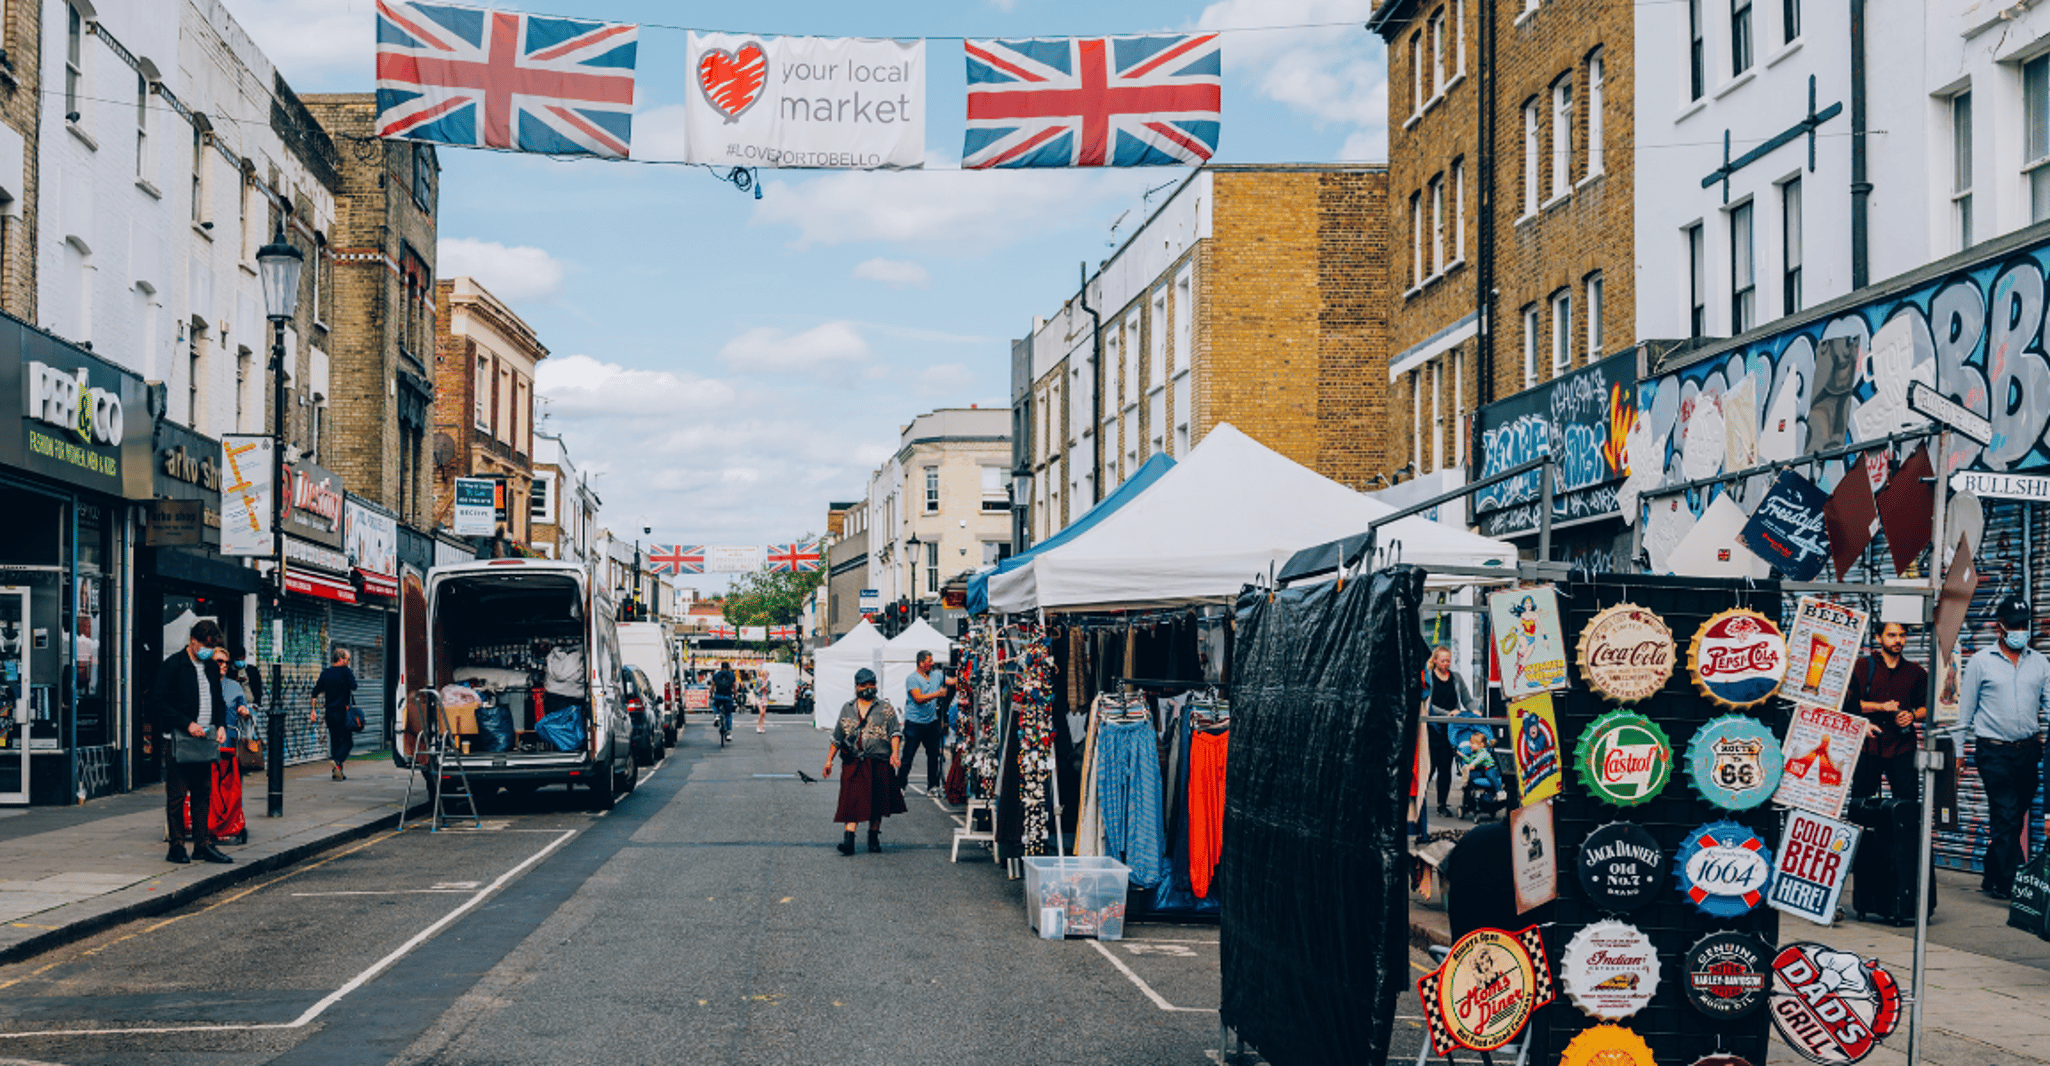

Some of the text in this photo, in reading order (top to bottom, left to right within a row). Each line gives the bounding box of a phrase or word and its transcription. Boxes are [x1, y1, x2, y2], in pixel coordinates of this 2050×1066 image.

[781, 58, 908, 84] your local
[781, 91, 910, 124] market
[726, 144, 880, 166] #LOVEPORTOBELLO
[201, 456, 222, 493] sh
[1758, 495, 1824, 536] Freestyle
[1803, 605, 1859, 629] BEER
[1590, 641, 1668, 667] Coca-Cola
[1800, 709, 1861, 734] CHEERS
[1604, 746, 1658, 782] Castrol
[1720, 763, 1755, 784] 66
[1791, 817, 1832, 848] COLD
[1586, 845, 1615, 867] JACK
[1609, 863, 1637, 874] Old
[1781, 839, 1841, 887] BEER
[1696, 858, 1755, 887] 1664
[1607, 888, 1640, 896] BRAND
[1777, 876, 1825, 912] HERE!
[1586, 950, 1642, 965] Indian
[1697, 943, 1757, 963] GENUINE
[1693, 975, 1761, 985] HARLEY-DAVIDSON
[1459, 970, 1511, 1018] Mom's
[1699, 995, 1755, 1011] MOTOR OIL
[1781, 959, 1866, 1044] DAD'S
[1474, 988, 1523, 1036] Diner
[1776, 999, 1832, 1055] GRILL
